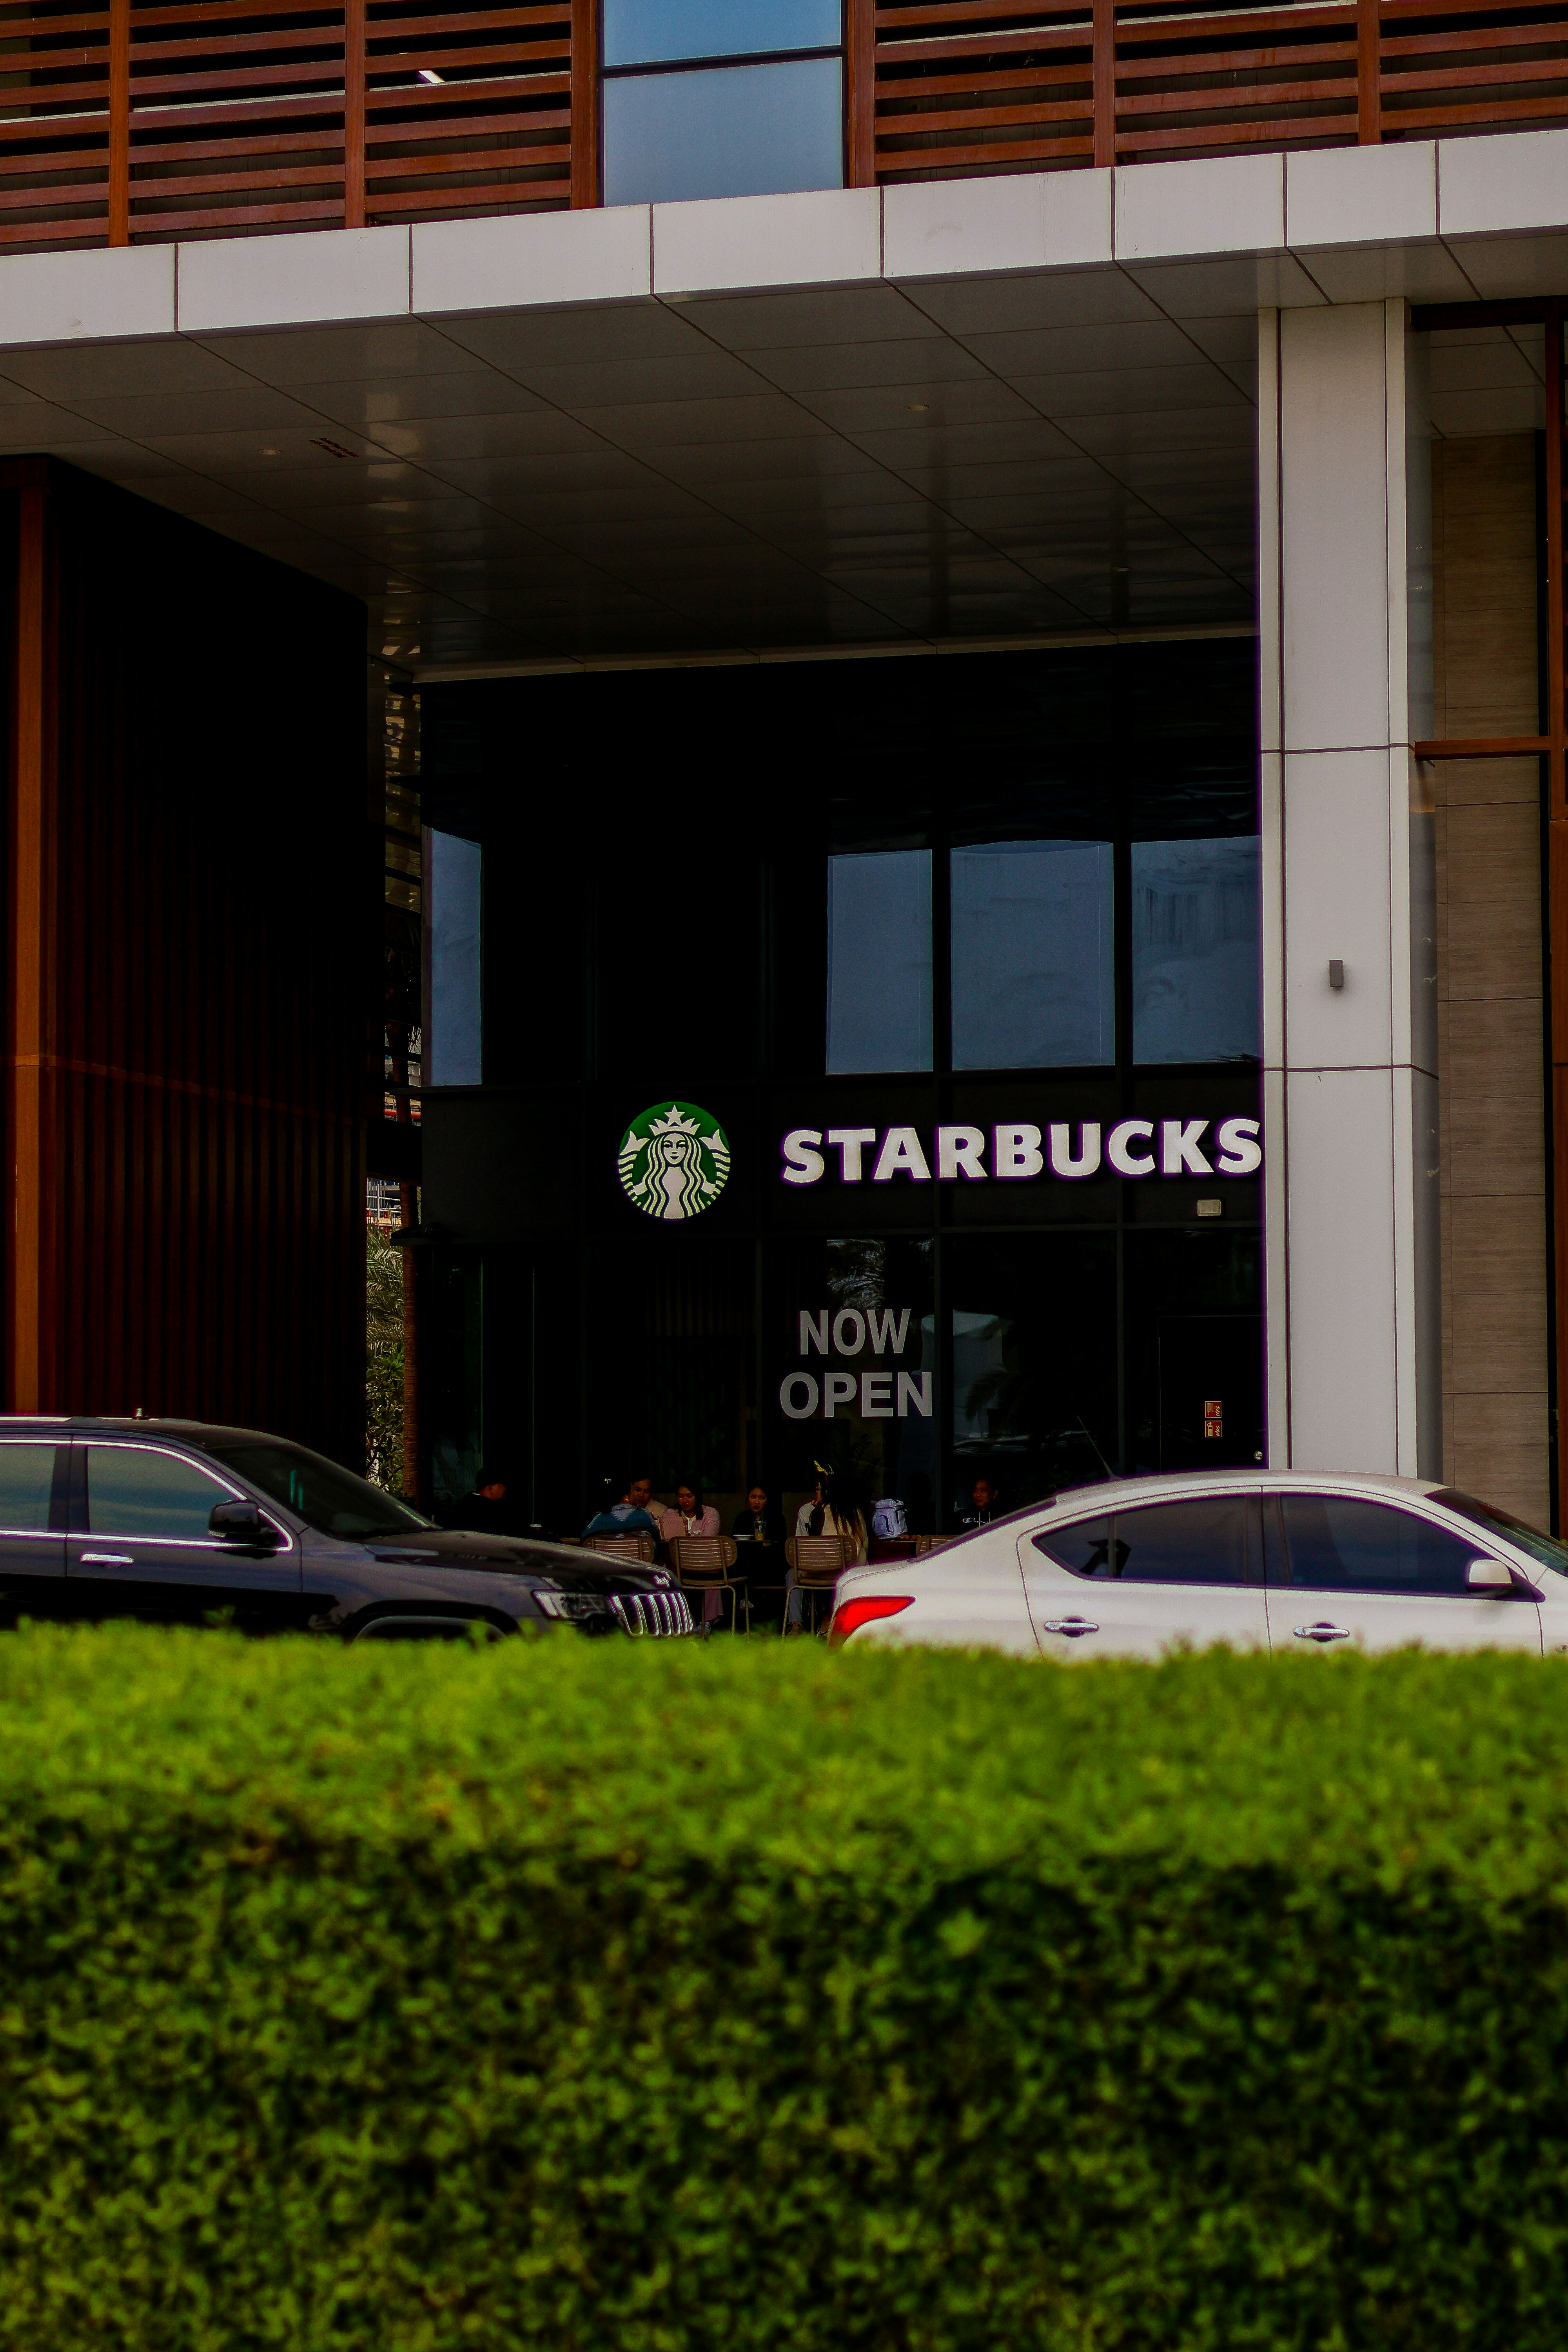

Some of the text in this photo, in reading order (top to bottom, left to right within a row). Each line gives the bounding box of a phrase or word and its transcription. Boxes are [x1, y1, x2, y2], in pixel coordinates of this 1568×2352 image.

[783, 1118, 1262, 1183] STARBUCKS
[800, 1308, 911, 1356] NOW
[780, 1372, 932, 1419] OPEN
